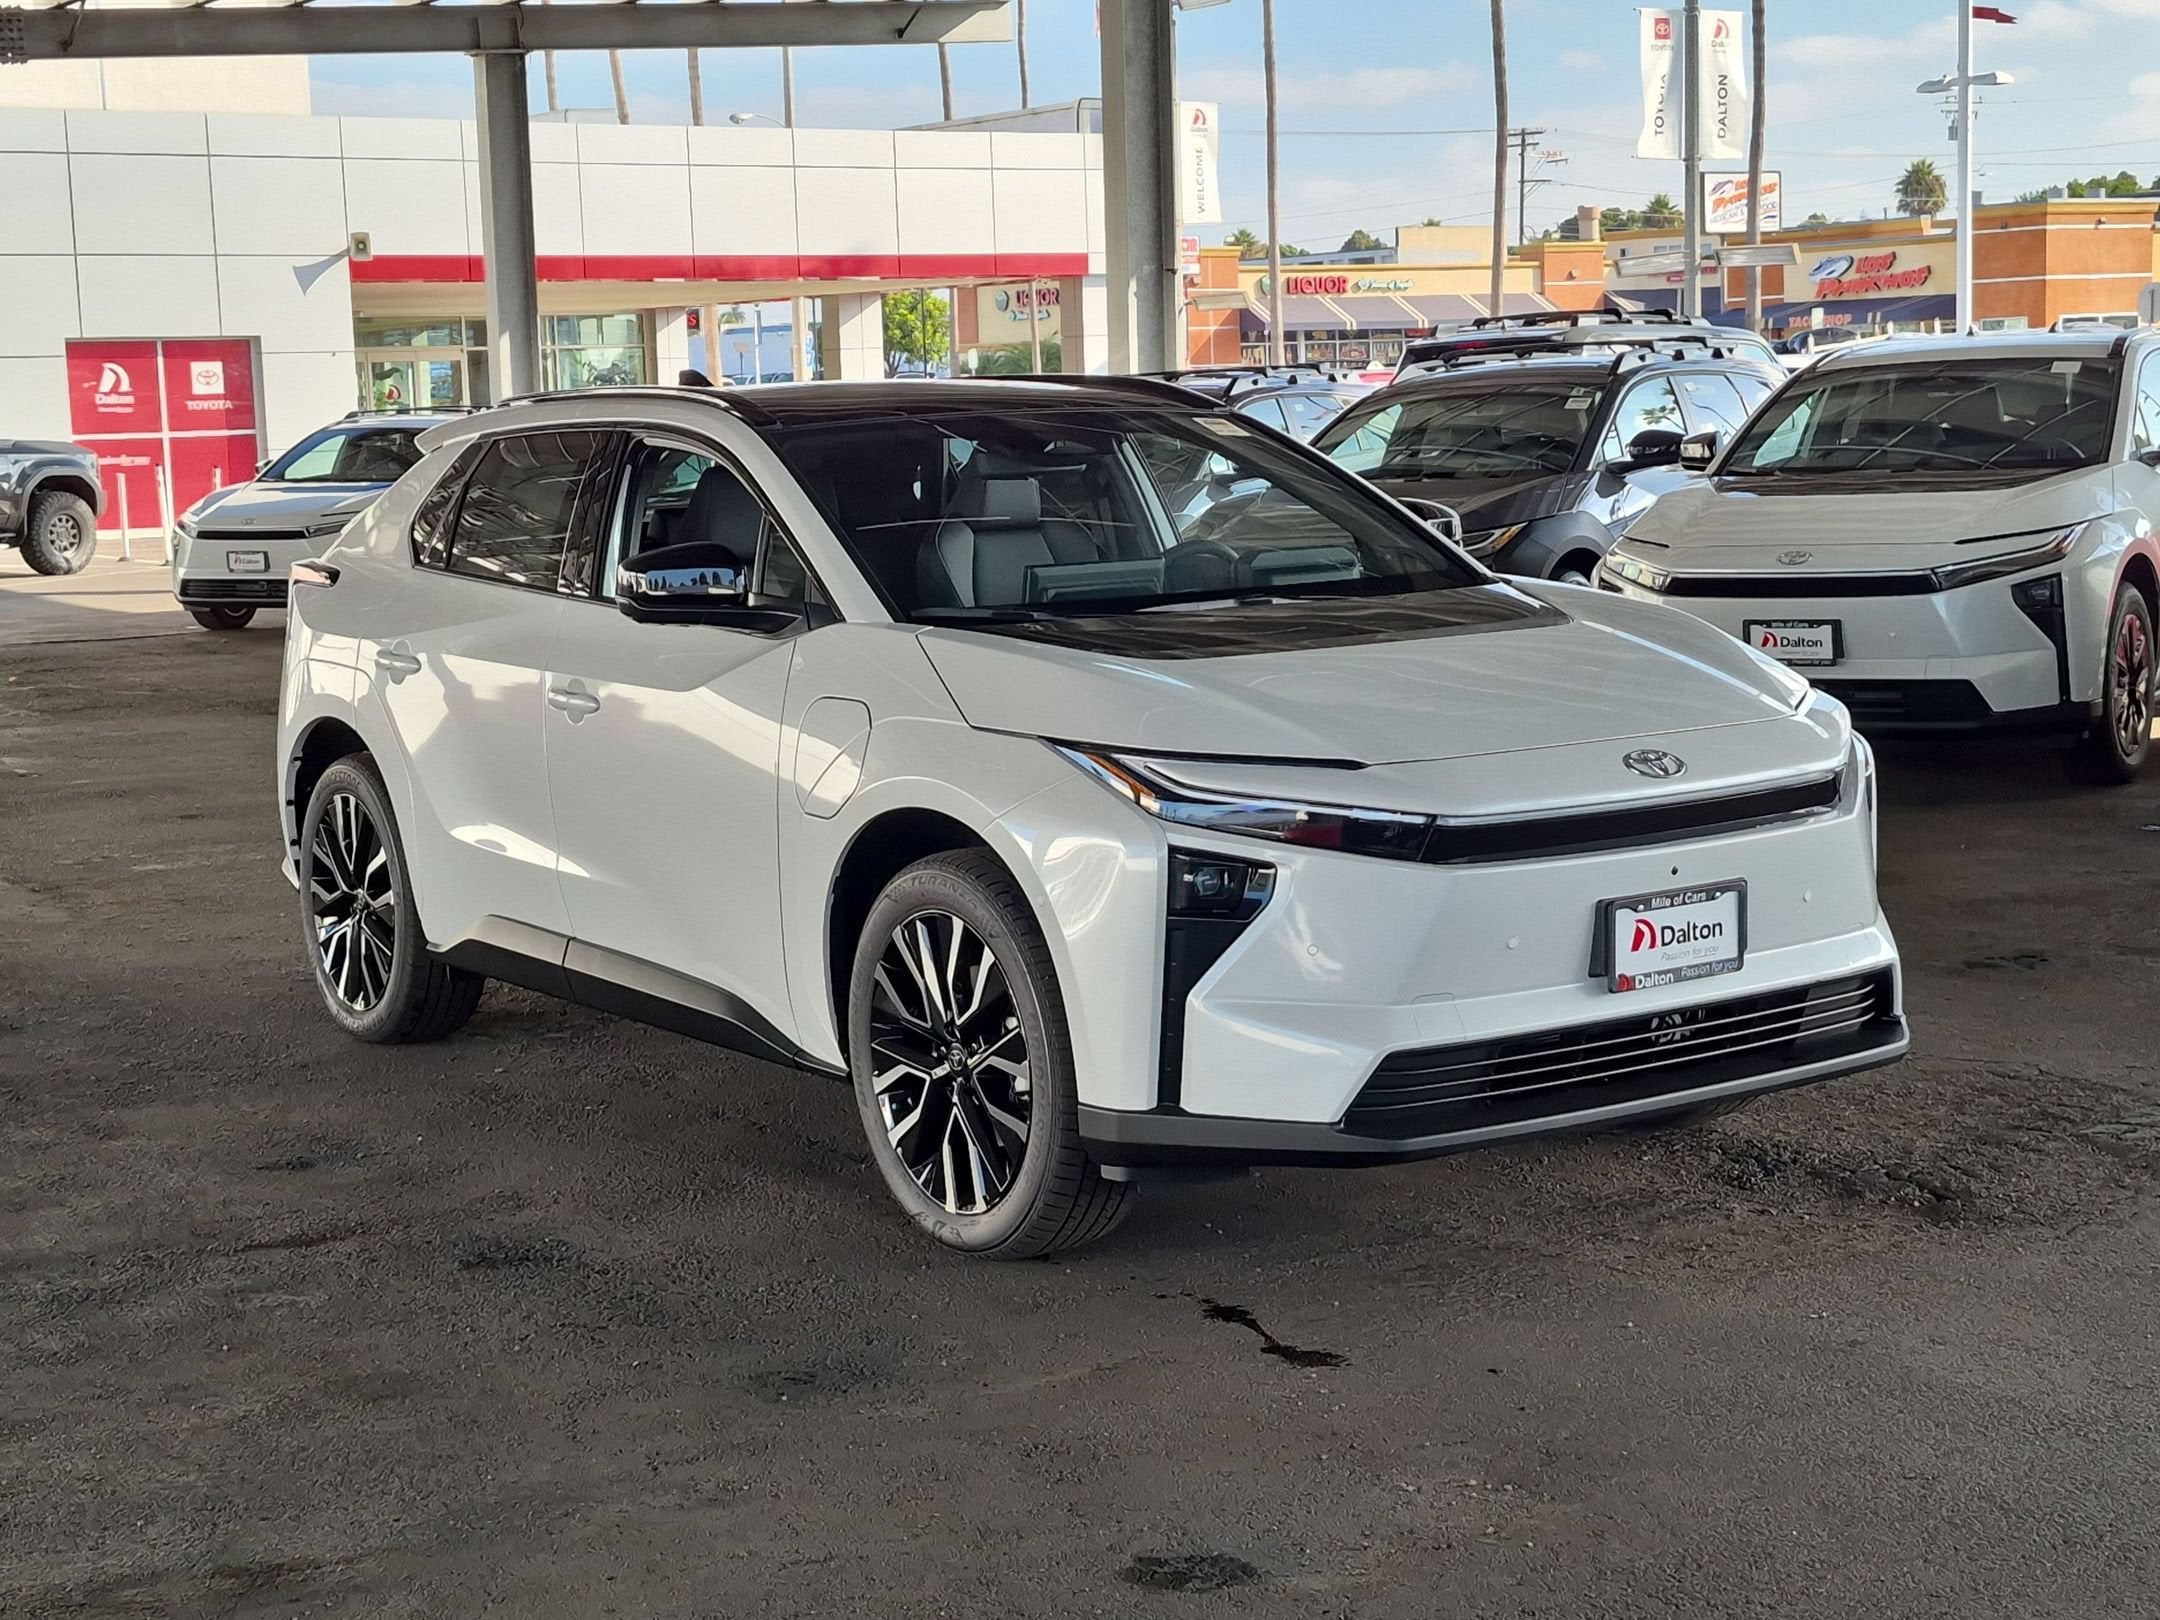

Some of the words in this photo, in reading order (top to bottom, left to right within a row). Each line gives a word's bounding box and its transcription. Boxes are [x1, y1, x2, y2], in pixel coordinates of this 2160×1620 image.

[1717, 74, 1728, 139] DALTON
[1195, 147, 1206, 214] WELCOME
[1856, 251, 1897, 275] LOS
[1288, 276, 1349, 294] LIQUOR
[185, 400, 234, 411] TOYOTA
[1780, 636, 1823, 648] Dalton
[1651, 896, 1671, 908] Mile
[1673, 892, 1684, 906] of
[1685, 891, 1708, 903] Cars
[1660, 921, 1724, 947] Dalton
[1634, 971, 1675, 988] Dalton
[1680, 962, 1710, 977] Passion
[1711, 961, 1723, 973] for
[1724, 959, 1738, 973] you
